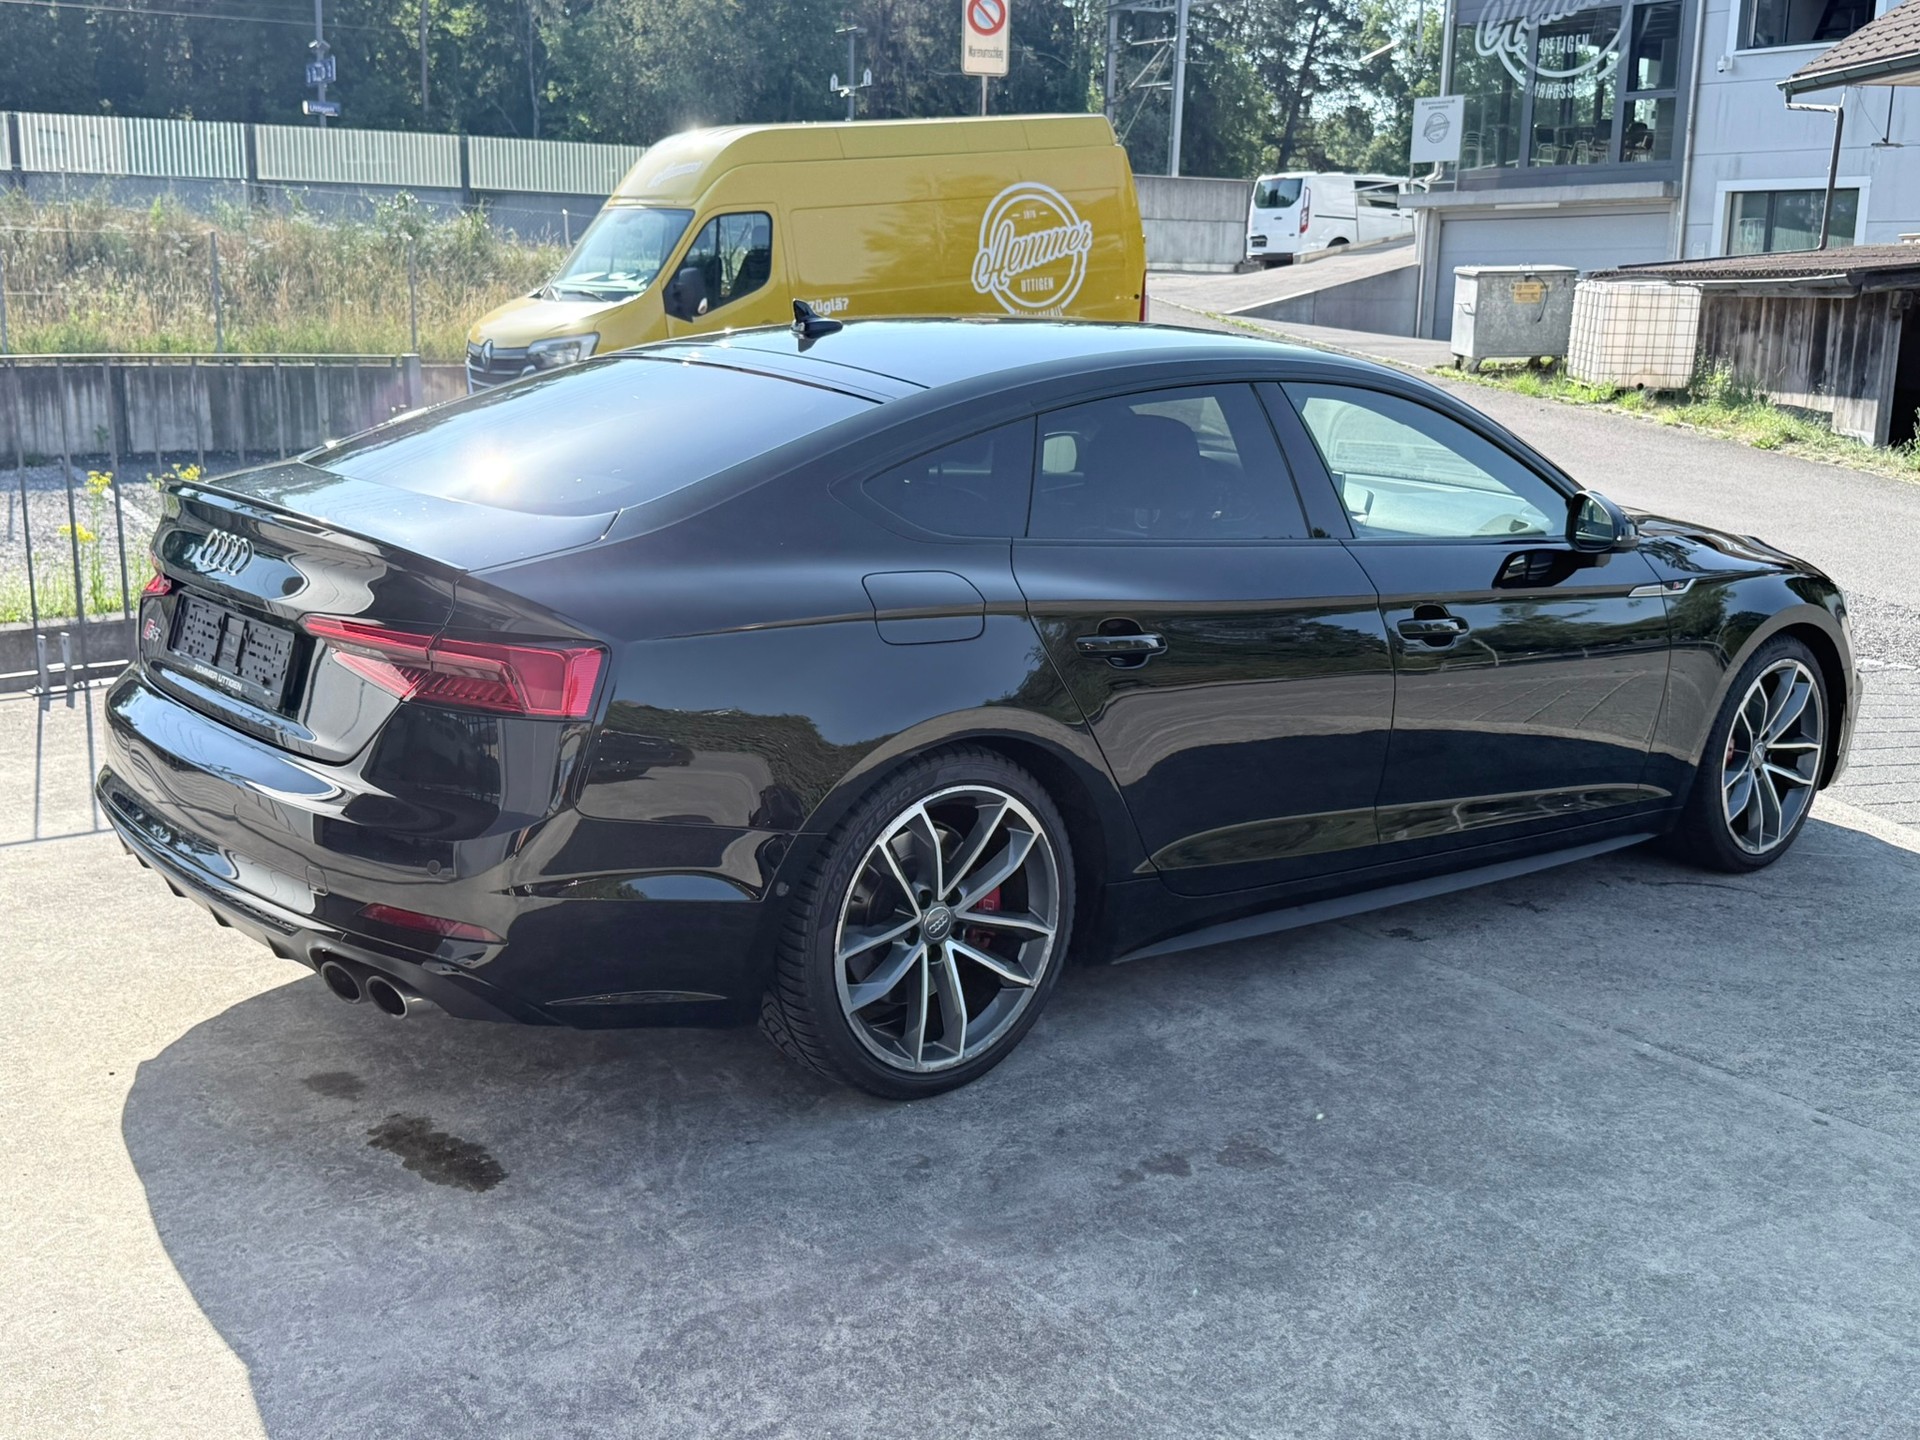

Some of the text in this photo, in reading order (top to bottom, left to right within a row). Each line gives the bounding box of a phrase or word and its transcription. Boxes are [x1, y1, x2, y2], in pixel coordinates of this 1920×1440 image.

[1541, 33, 1590, 55] UTTIGEN
[1020, 277, 1054, 293] UTTIGEN
[194, 664, 243, 692] AEMMER UTTIGEN
[828, 786, 912, 905] SOTTOZERO
